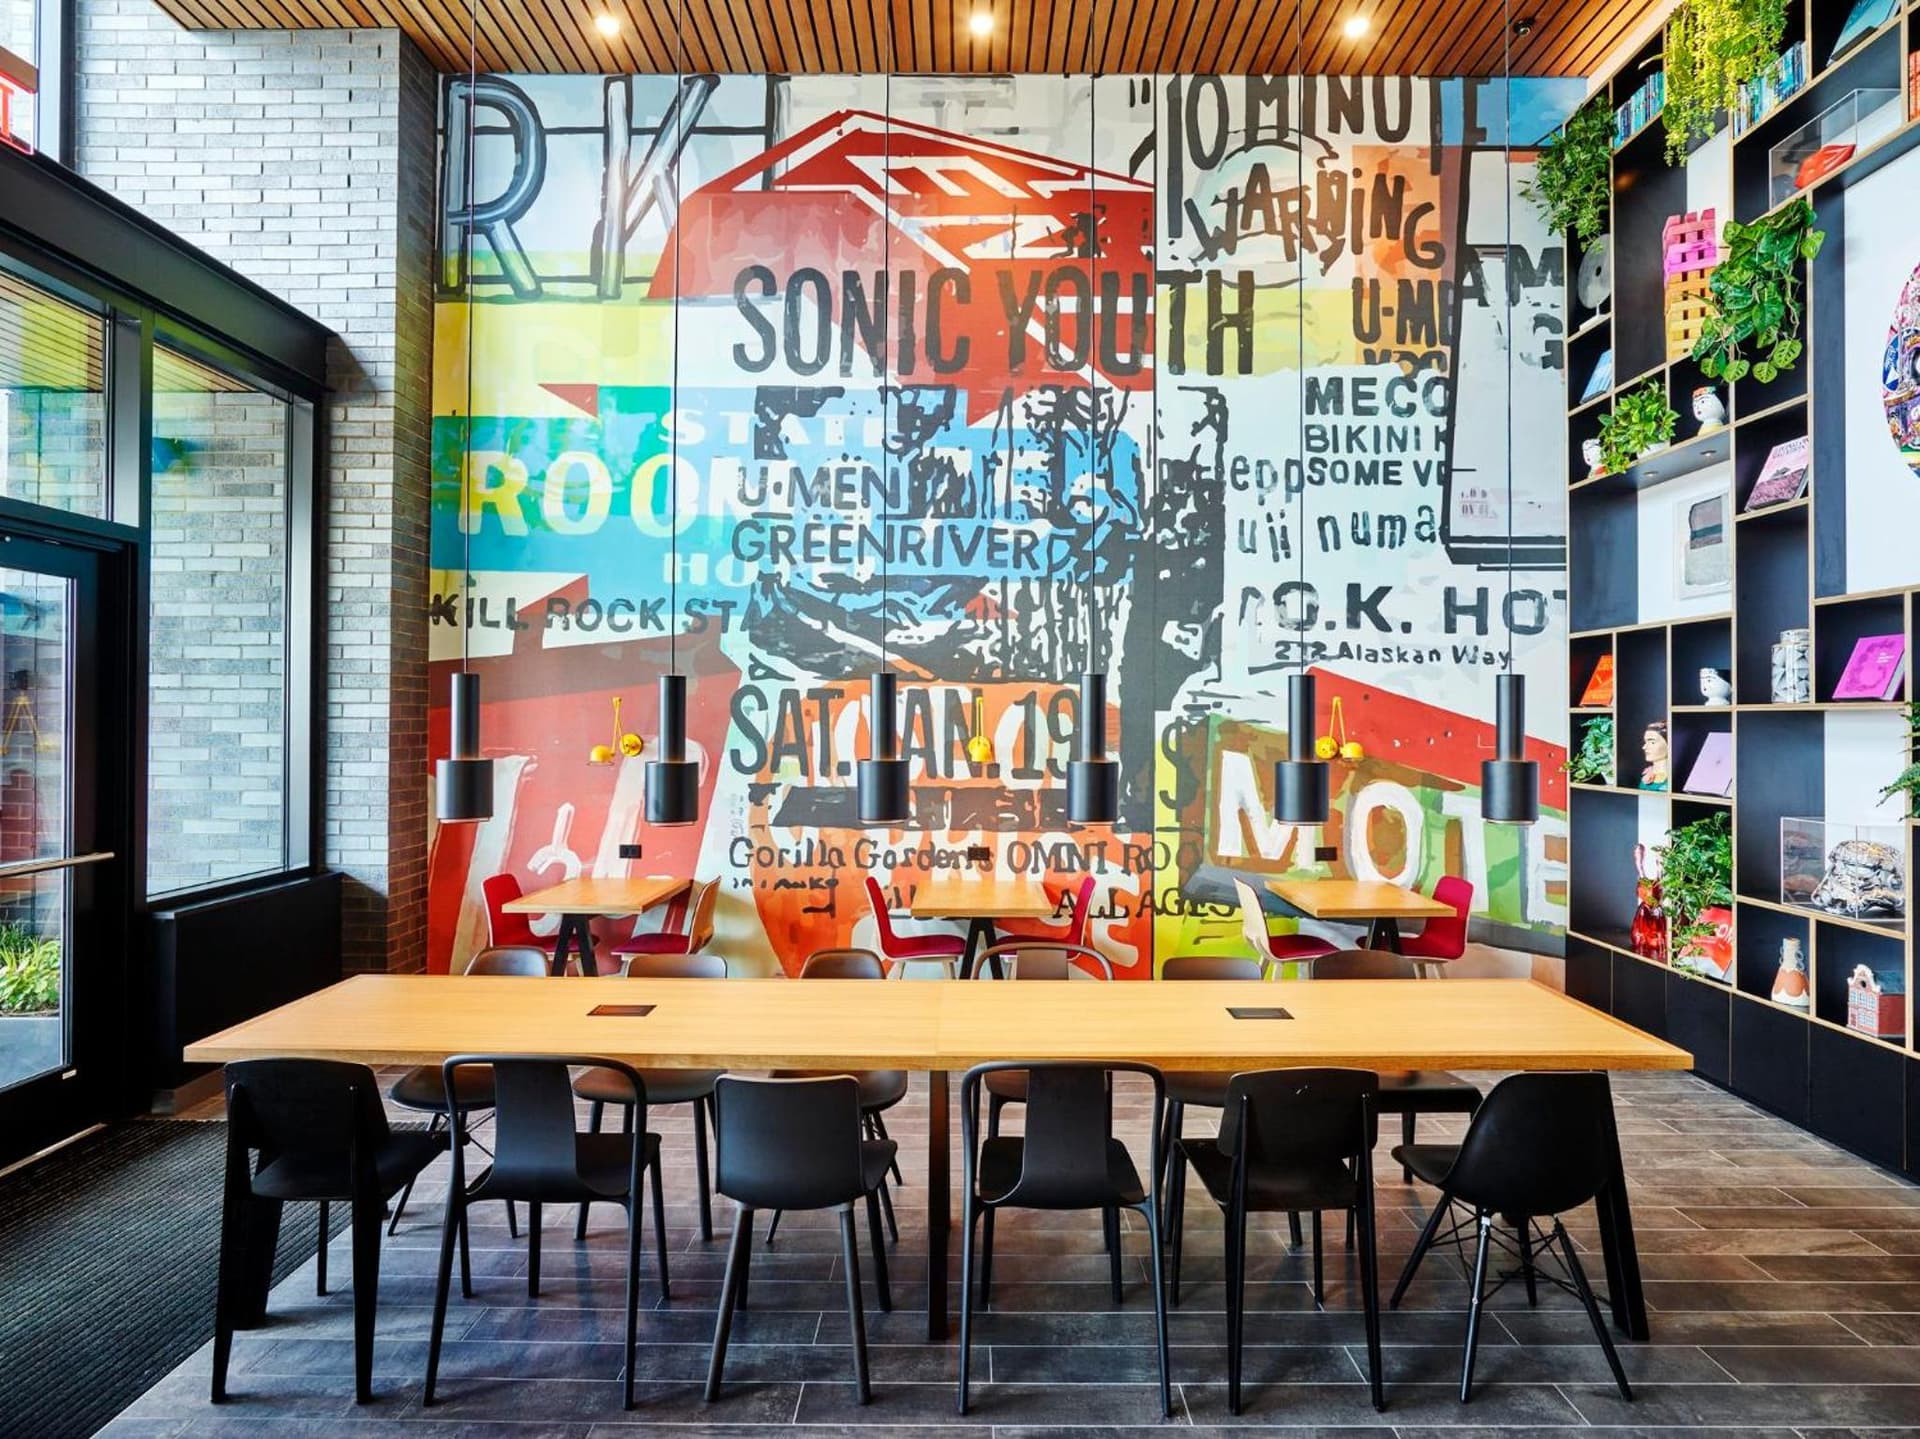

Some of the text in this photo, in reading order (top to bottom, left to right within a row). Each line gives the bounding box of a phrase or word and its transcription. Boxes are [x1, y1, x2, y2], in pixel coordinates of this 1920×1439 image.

[1245, 74, 1493, 176] MINUTE
[733, 265, 1255, 378] SONIC YOUTH
[1305, 424, 1421, 453] BIKINI
[1306, 457, 1403, 486] SOME
[430, 593, 529, 630] KILL
[545, 597, 666, 632] ROCK
[1272, 581, 1413, 634] O.K.
[1338, 641, 1442, 665] Alaskan
[1451, 645, 1514, 670] Way
[730, 684, 851, 777] SAT.
[729, 836, 846, 869] Gorilla
[1007, 840, 1108, 874] OMNI
